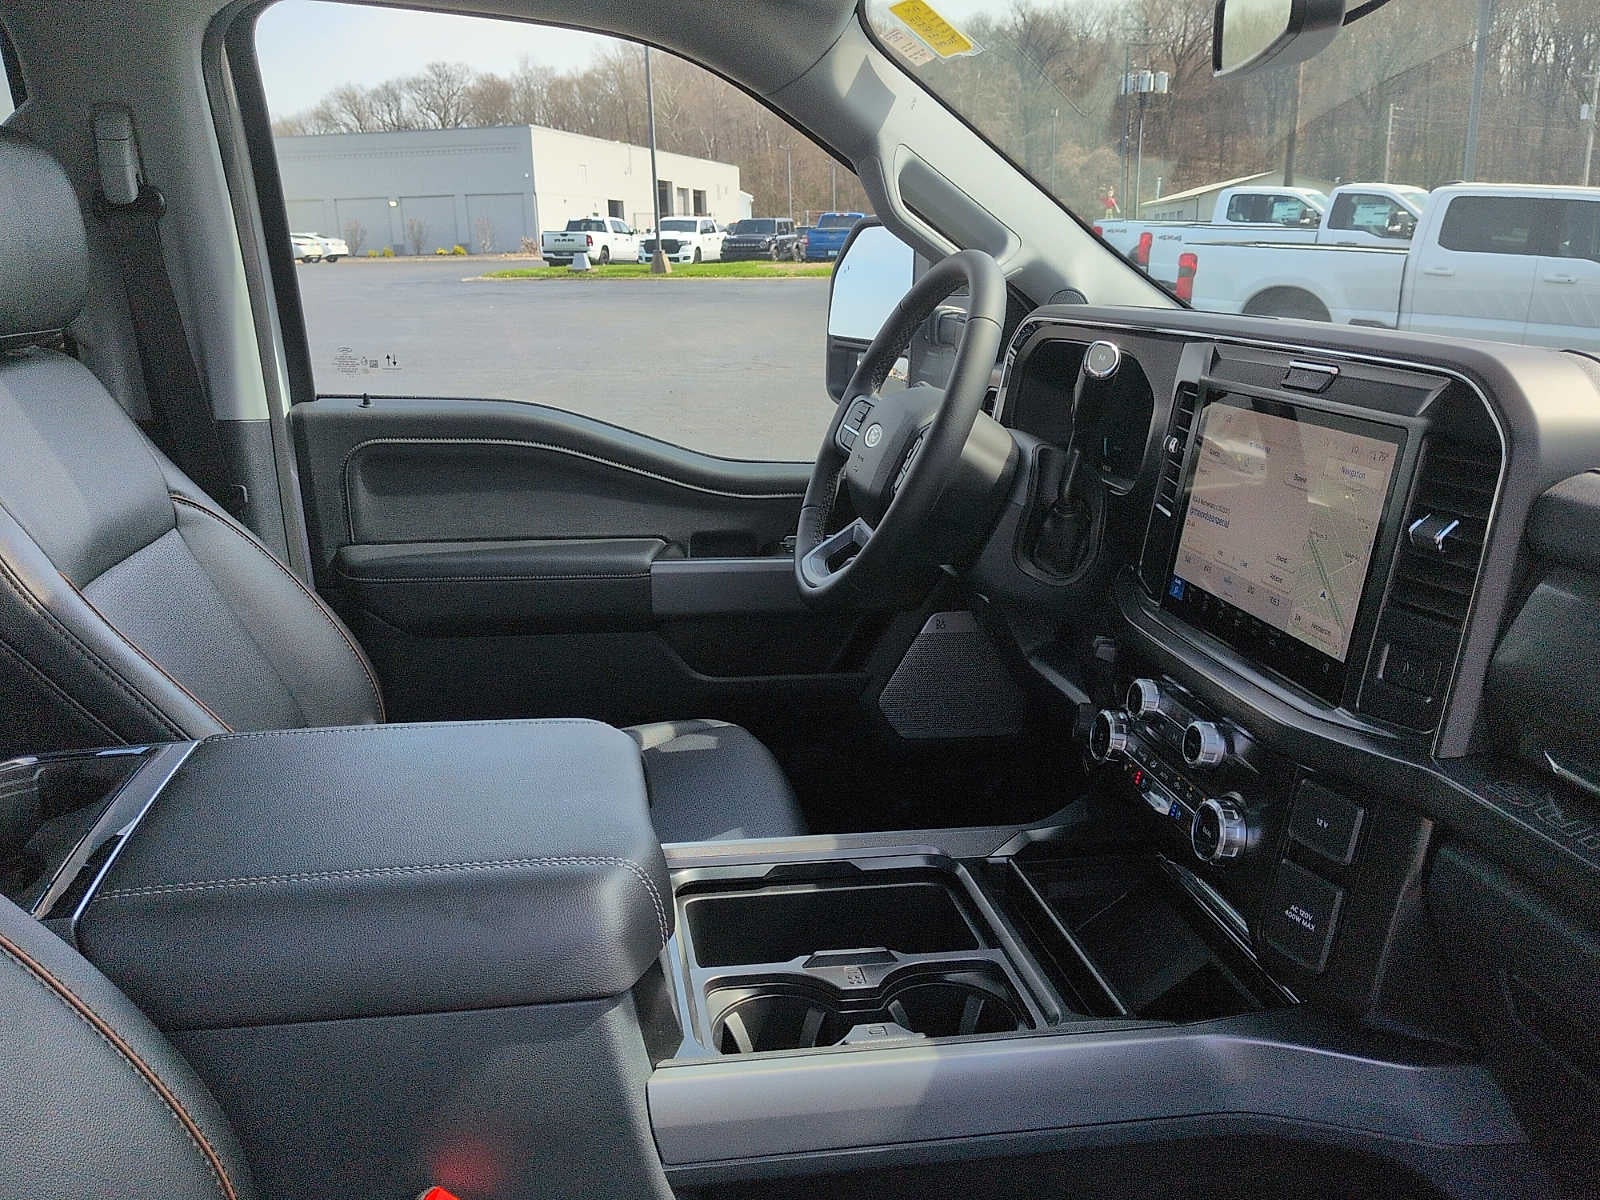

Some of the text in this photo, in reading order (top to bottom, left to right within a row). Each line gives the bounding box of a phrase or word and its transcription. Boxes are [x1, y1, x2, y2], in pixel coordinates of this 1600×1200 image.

[1290, 904, 1313, 921] AC 120V
[1301, 918, 1316, 933] MAX
